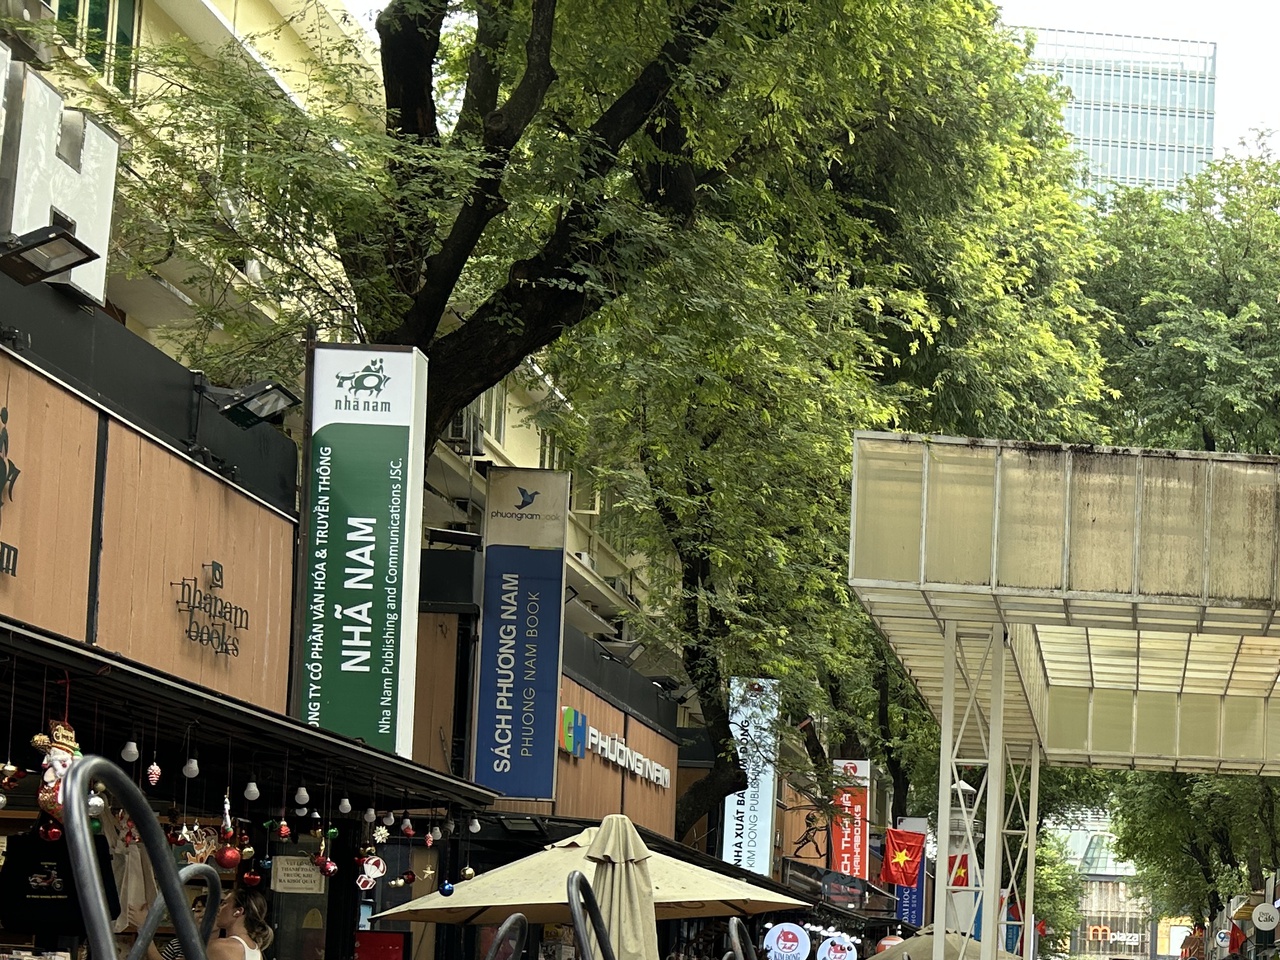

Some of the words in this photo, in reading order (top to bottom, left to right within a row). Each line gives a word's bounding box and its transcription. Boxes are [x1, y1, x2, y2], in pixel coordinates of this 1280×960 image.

[335, 396, 359, 411] nhã
[363, 400, 391, 412] nam
[315, 446, 332, 492] THÔNG
[389, 458, 403, 482] JSC.
[312, 496, 331, 546] TRUYỀN
[385, 484, 402, 584] Communications
[316, 549, 328, 559] &
[343, 517, 377, 590] NAM
[311, 562, 327, 590] HÓA
[310, 592, 326, 621] VĂN
[384, 587, 397, 610] and
[500, 573, 519, 620] NAM
[526, 591, 540, 638] BOOK
[306, 624, 325, 659] PHẦN
[334, 602, 373, 672] NHÃ
[381, 613, 398, 675] Publishing
[304, 662, 323, 680] CỔ
[495, 625, 517, 710] PHƯƠNG
[525, 650, 537, 681] NAM
[308, 683, 322, 699] TY
[380, 678, 393, 706] Nam
[378, 709, 391, 734] Nha
[521, 688, 536, 757] PHUONG
[491, 715, 512, 773] SÁCH
[733, 809, 745, 839] XUẤT
[748, 815, 758, 847] DONG
[733, 841, 743, 867] NHÀ
[746, 850, 756, 868] KIM
